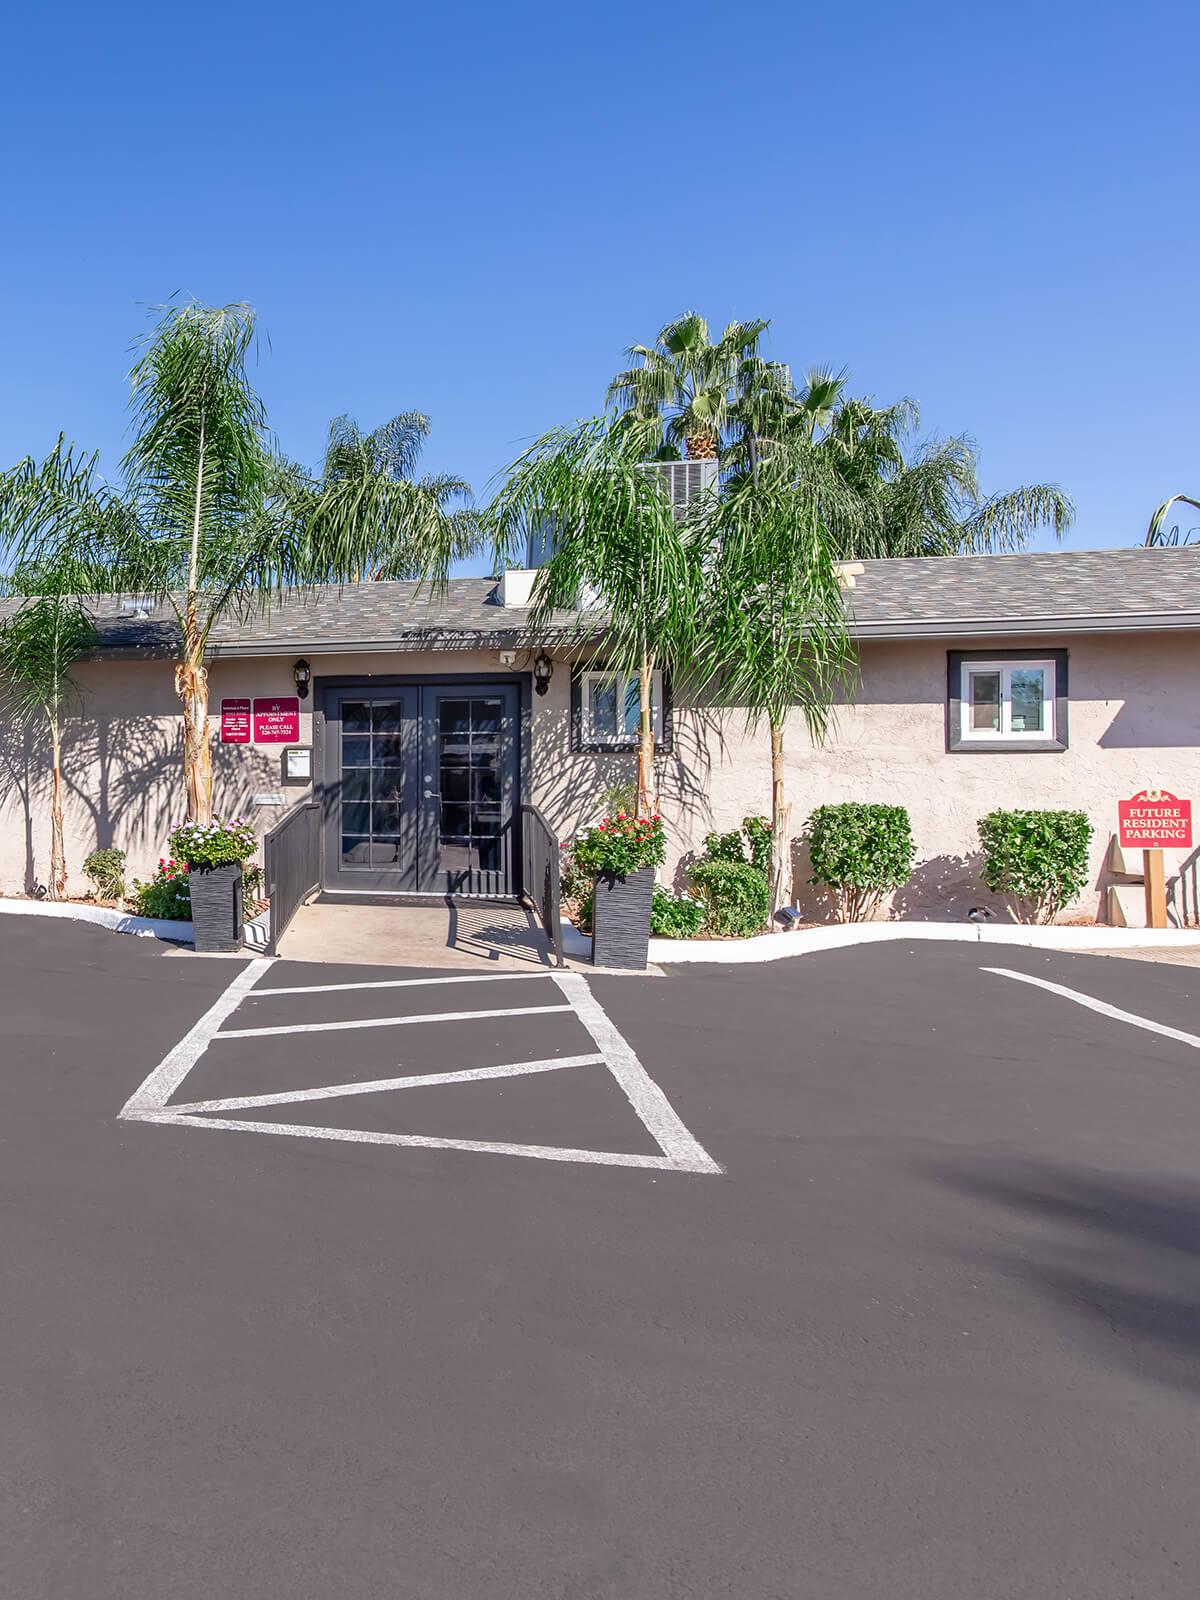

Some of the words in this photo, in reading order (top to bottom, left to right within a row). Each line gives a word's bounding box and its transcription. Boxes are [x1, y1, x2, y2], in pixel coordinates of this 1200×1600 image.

[1129, 808, 1180, 817] FUTURE
[1123, 819, 1188, 828] RESIDENT
[1126, 830, 1185, 838] PARKING
